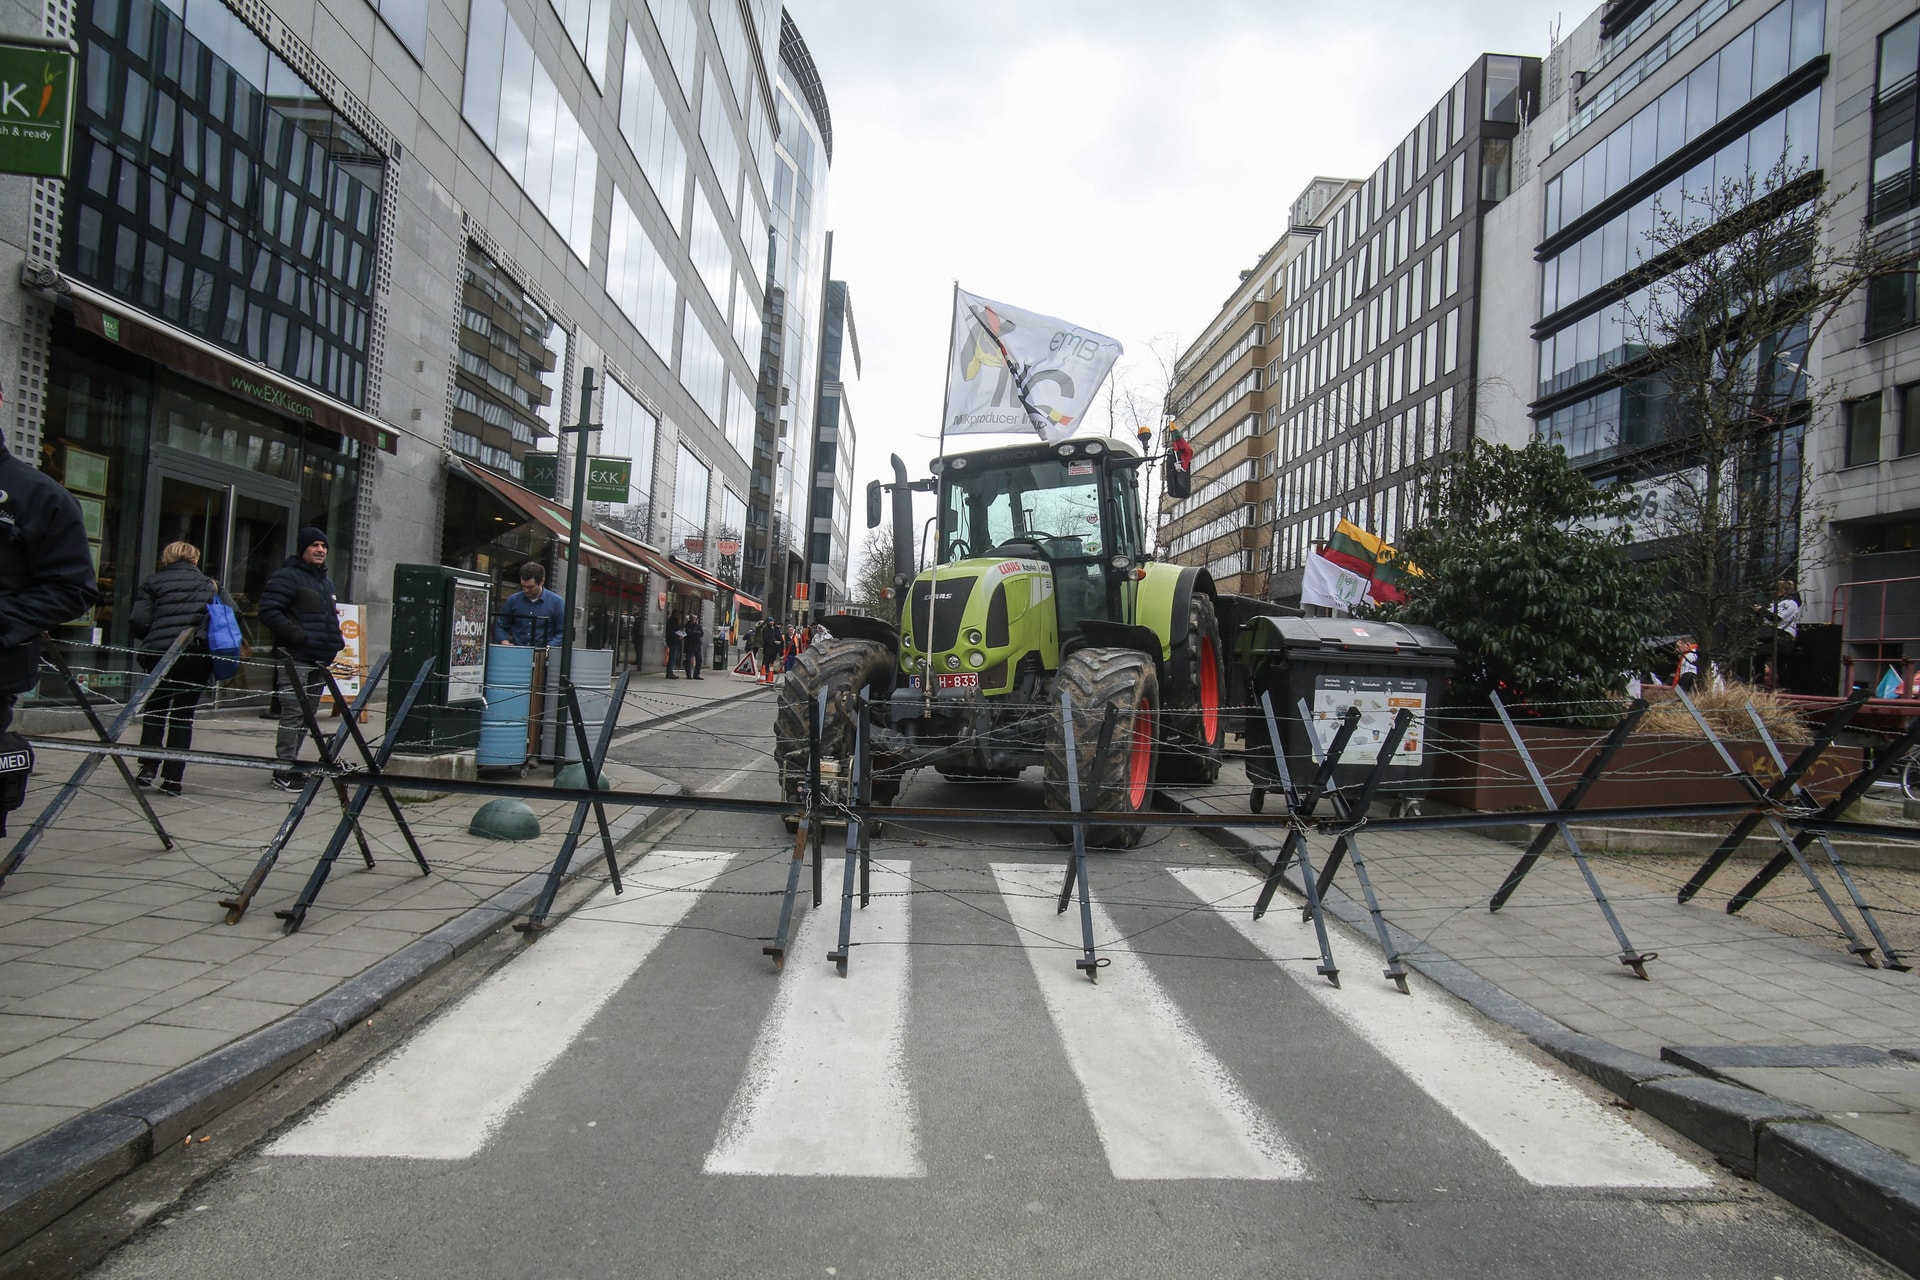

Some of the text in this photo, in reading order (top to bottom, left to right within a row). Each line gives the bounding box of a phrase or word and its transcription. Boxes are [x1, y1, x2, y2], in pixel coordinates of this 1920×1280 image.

[12, 127, 20, 137] &
[23, 129, 52, 141] ready
[989, 448, 1037, 462] ARION
[998, 561, 1021, 575] CLAAS
[455, 615, 485, 635] elbow
